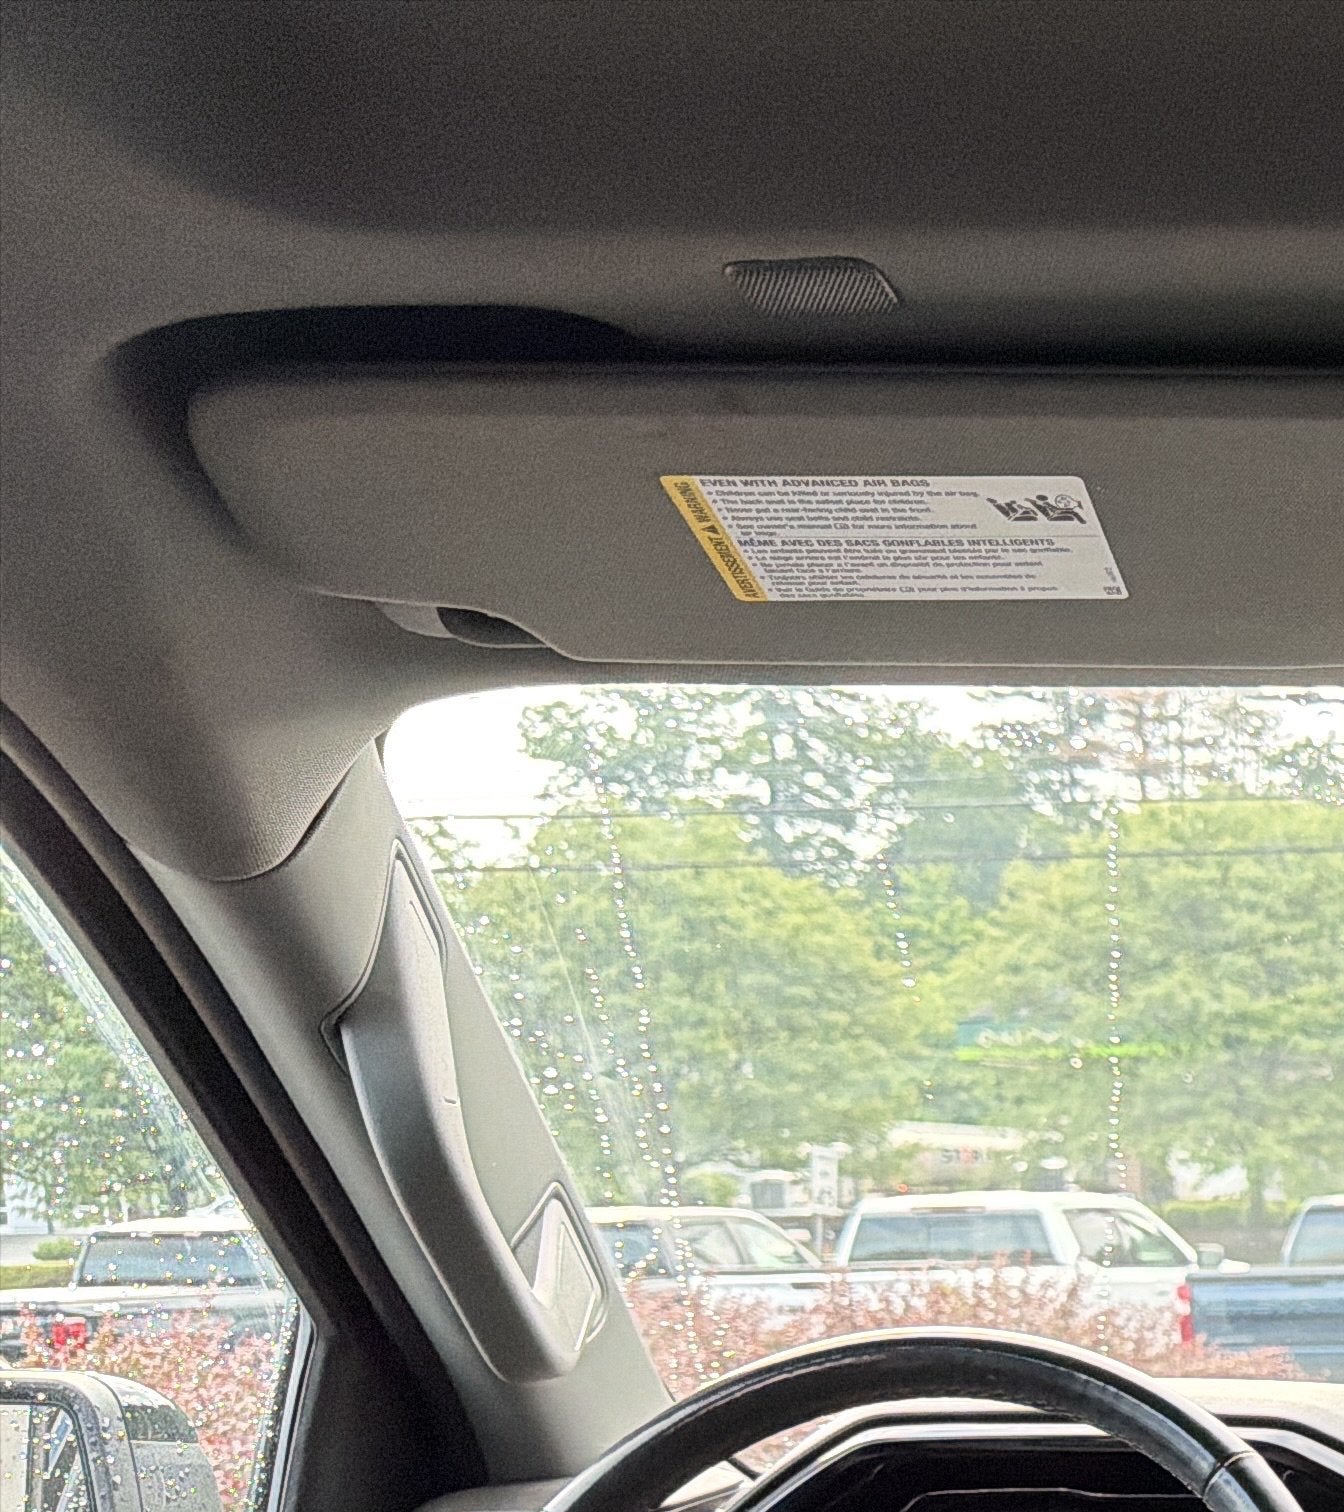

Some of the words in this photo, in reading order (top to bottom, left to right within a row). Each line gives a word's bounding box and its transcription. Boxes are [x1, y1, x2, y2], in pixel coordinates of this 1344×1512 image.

[701, 479, 737, 487] EVEN
[743, 479, 778, 487] WITH
[782, 479, 858, 487] ADVANCED
[863, 479, 888, 487] AIR
[890, 479, 930, 487] BAGS
[674, 482, 711, 522] WARNING
[737, 539, 778, 547] MÊME
[882, 539, 964, 547] GONFLABLES
